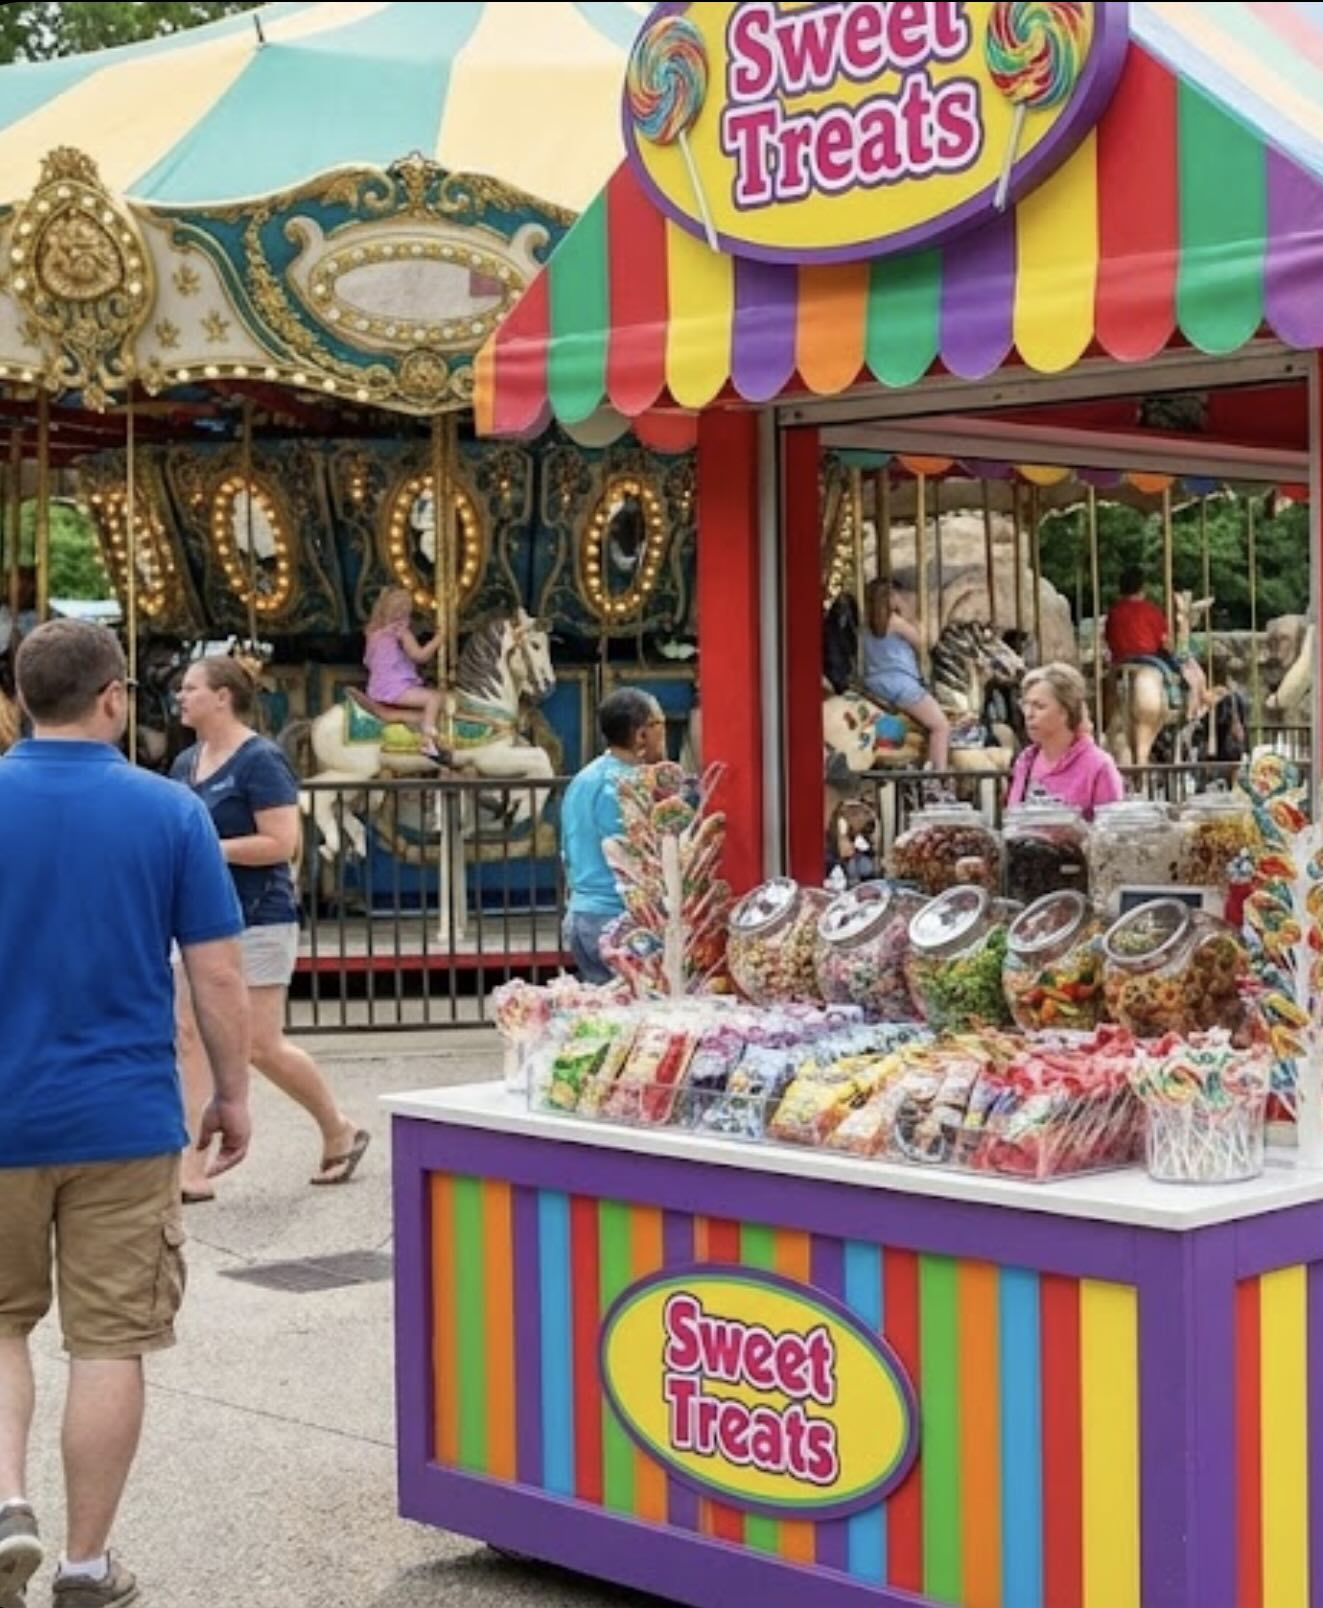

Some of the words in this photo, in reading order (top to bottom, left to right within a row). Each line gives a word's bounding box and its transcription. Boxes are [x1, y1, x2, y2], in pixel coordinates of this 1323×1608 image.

[725, 73, 978, 205] Treats
[665, 1294, 835, 1404] Sweet
[664, 1374, 838, 1484] Treats
